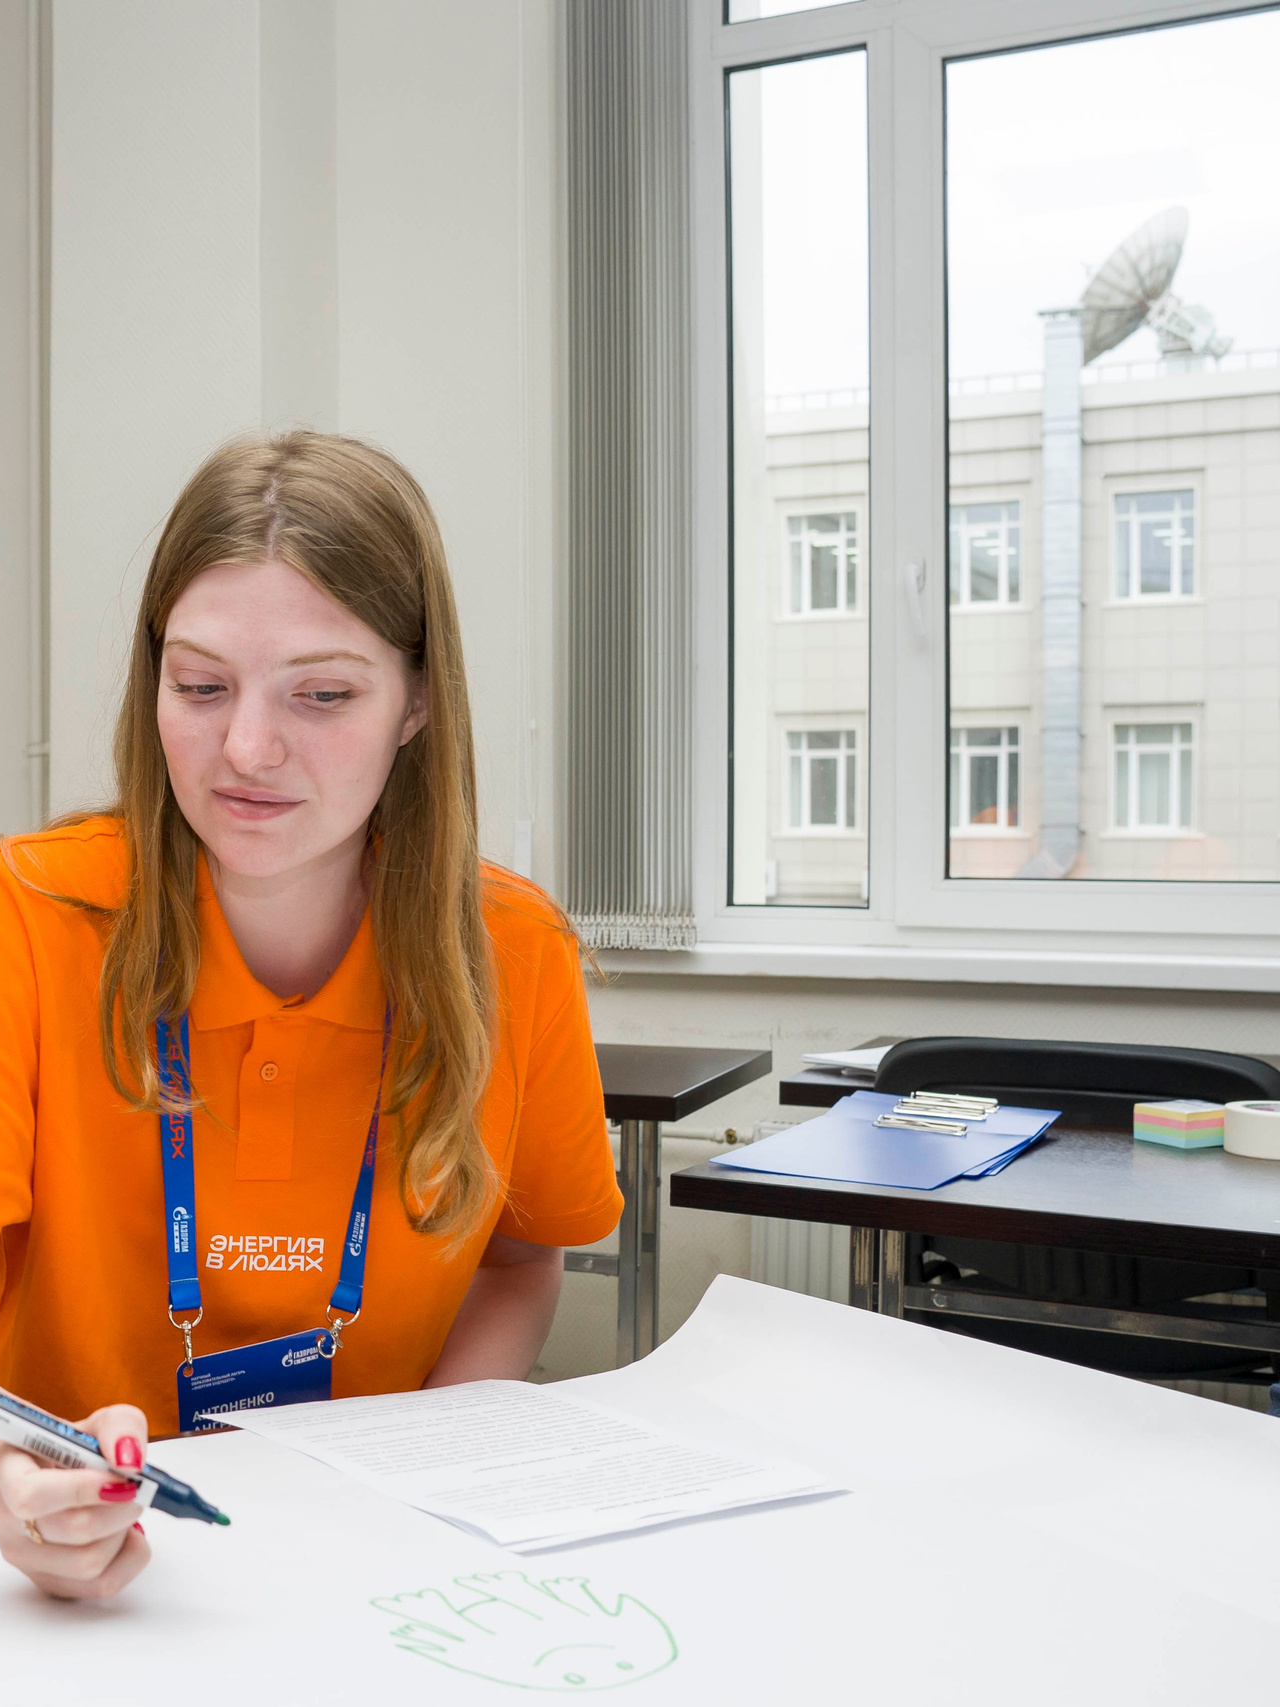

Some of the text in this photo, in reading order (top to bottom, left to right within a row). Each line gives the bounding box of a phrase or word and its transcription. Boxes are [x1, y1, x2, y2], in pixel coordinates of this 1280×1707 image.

[180, 1221, 189, 1252] ГАЗПРОМ
[351, 1211, 361, 1242] ГАЗПРОМ
[209, 1234, 325, 1254] ЭНЕРГИЯ
[205, 1253, 323, 1272] В ЛЮДЯХ
[192, 1391, 275, 1423] АНТОНЕНКО
